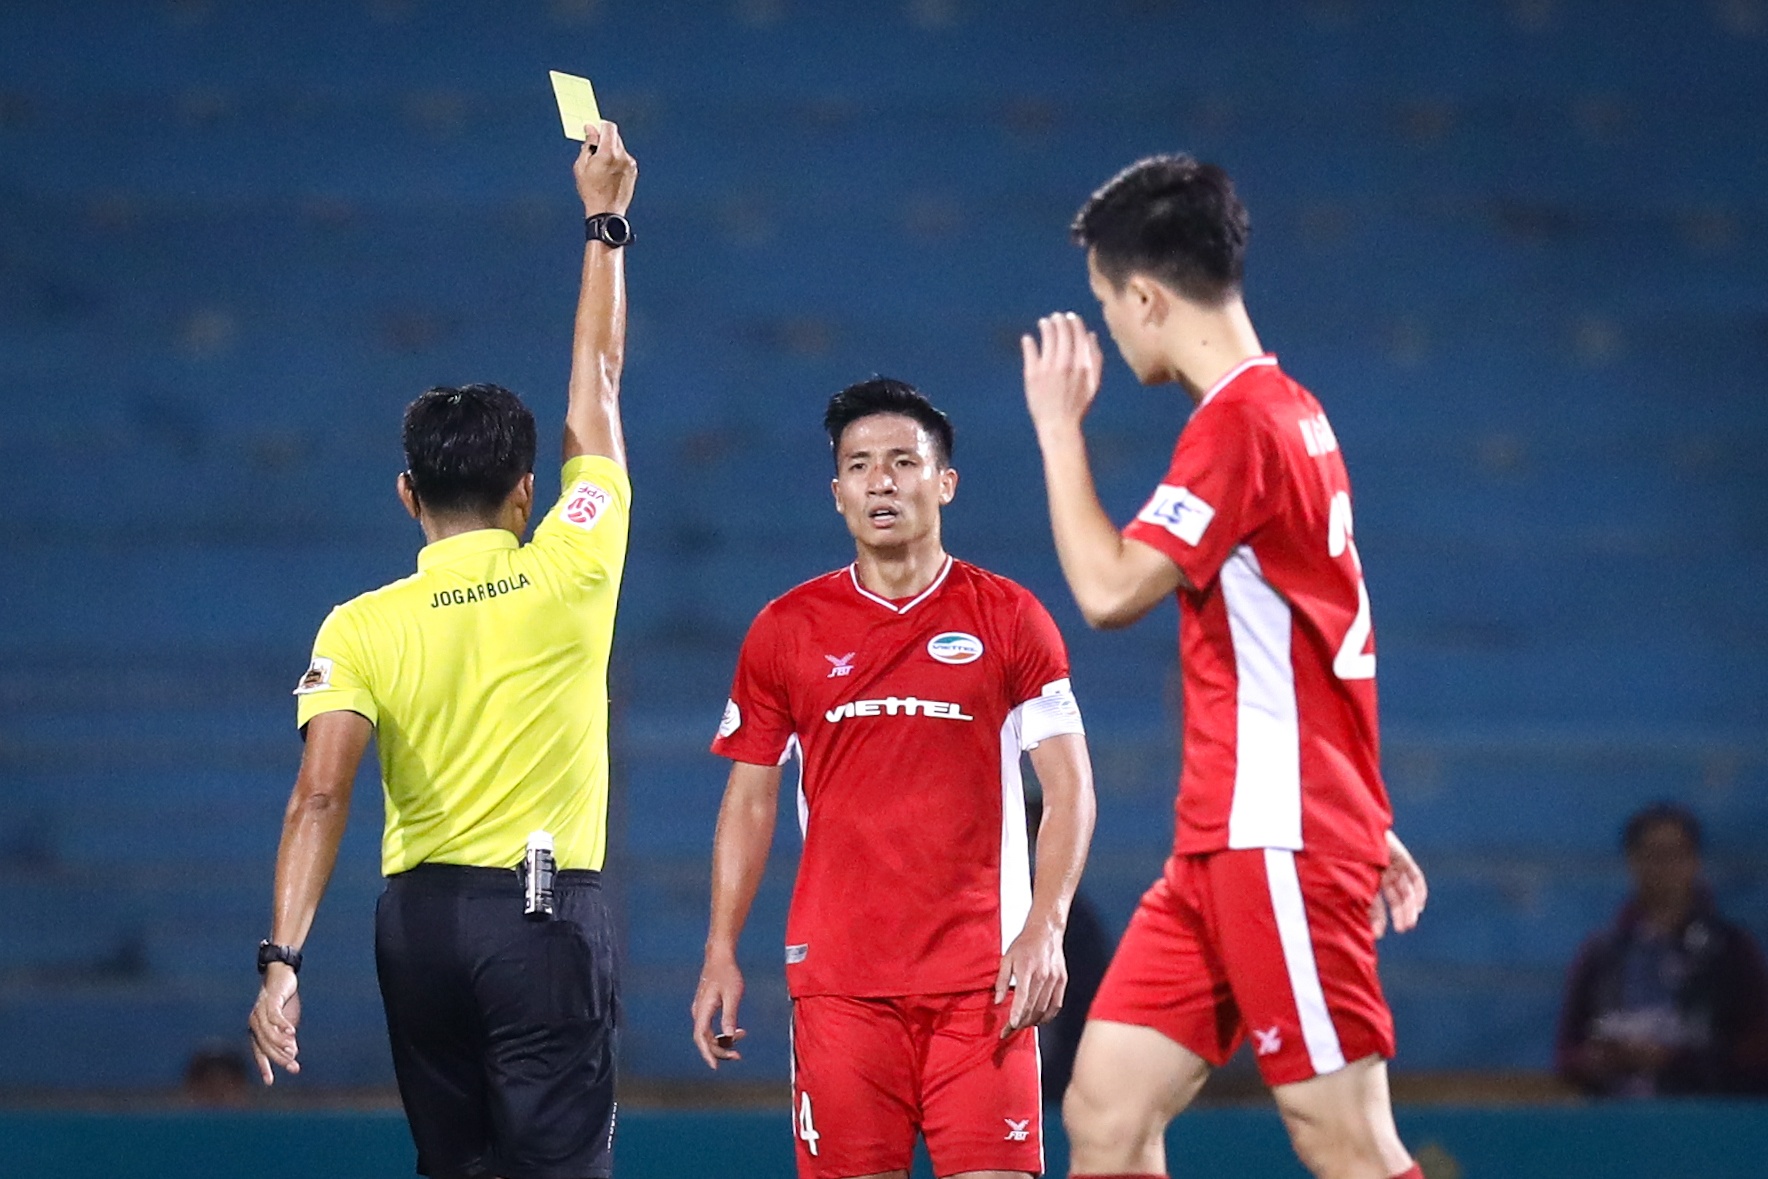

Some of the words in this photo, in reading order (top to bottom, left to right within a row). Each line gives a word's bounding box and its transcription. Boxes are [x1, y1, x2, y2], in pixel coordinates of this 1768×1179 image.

[577, 486, 605, 504] VPF
[431, 573, 531, 608] JOGARBOLA
[825, 696, 974, 723] VIETTEL
[799, 1090, 820, 1157] 4
